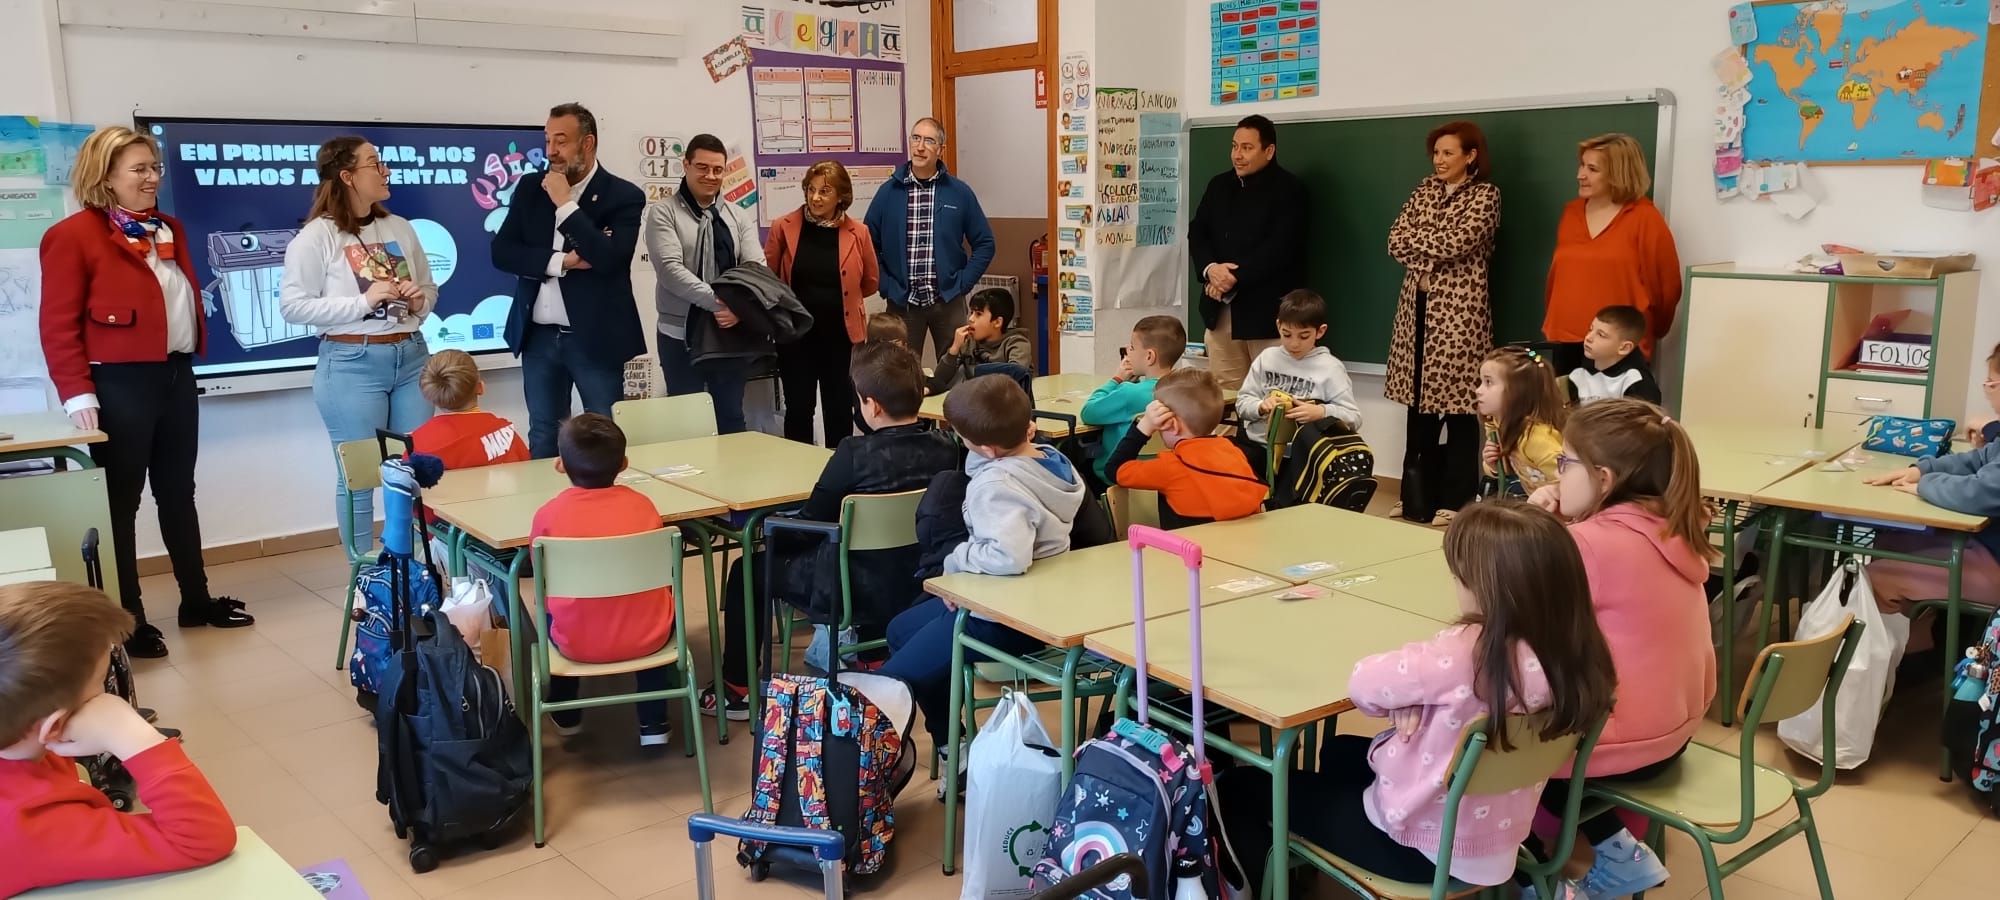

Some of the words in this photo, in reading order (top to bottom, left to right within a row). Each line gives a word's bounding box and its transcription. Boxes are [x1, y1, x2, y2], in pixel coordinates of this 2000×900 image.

[180, 144, 217, 161] EN
[429, 147, 476, 162] NOS
[194, 168, 296, 185] VAMOS
[301, 169, 320, 185] A
[1003, 827, 1014, 853] REDUCE
